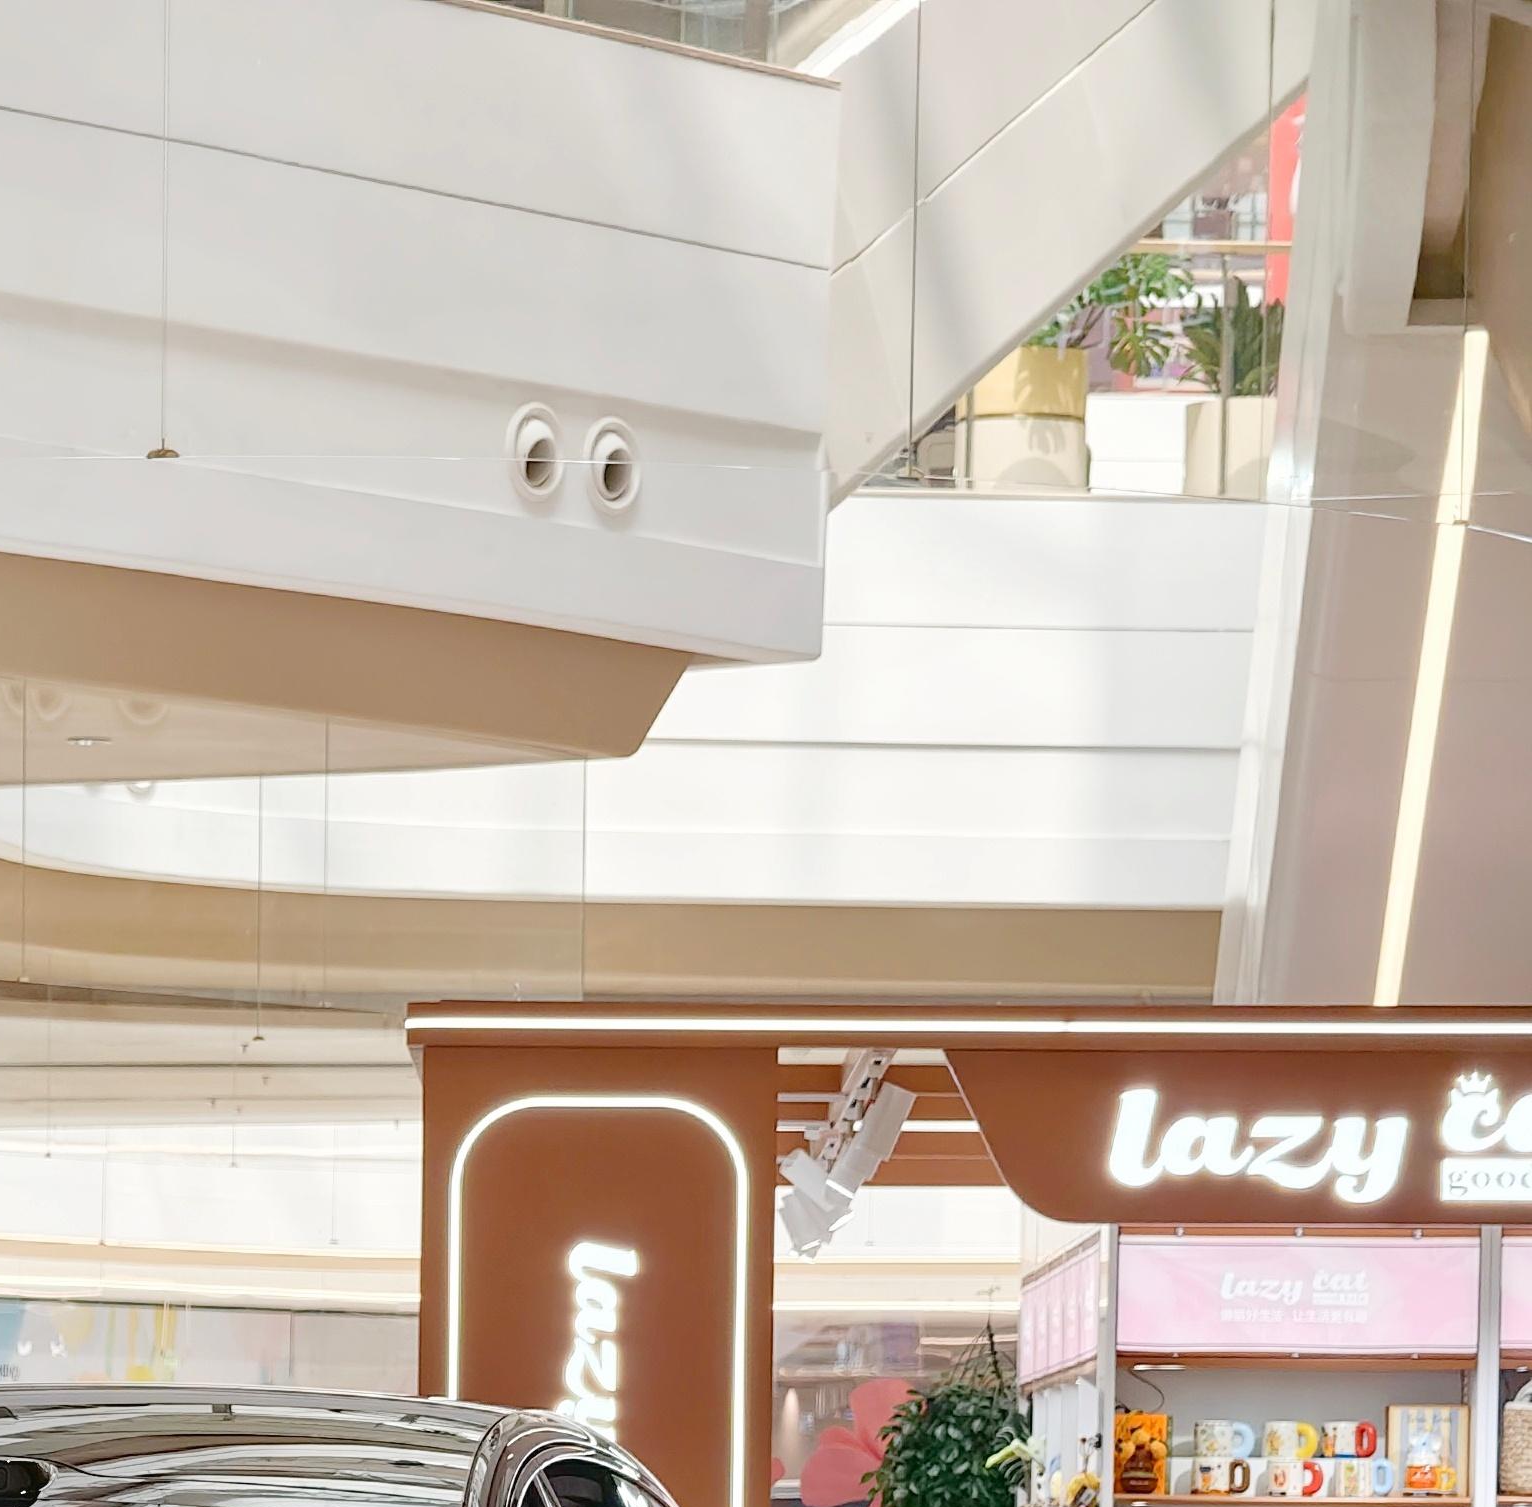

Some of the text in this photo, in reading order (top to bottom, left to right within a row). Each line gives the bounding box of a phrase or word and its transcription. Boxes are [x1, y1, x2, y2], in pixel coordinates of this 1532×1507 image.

[1108, 1088, 1409, 1204] lazy
[1220, 1271, 1304, 1306] lazy
[1313, 1269, 1368, 1291] cat
